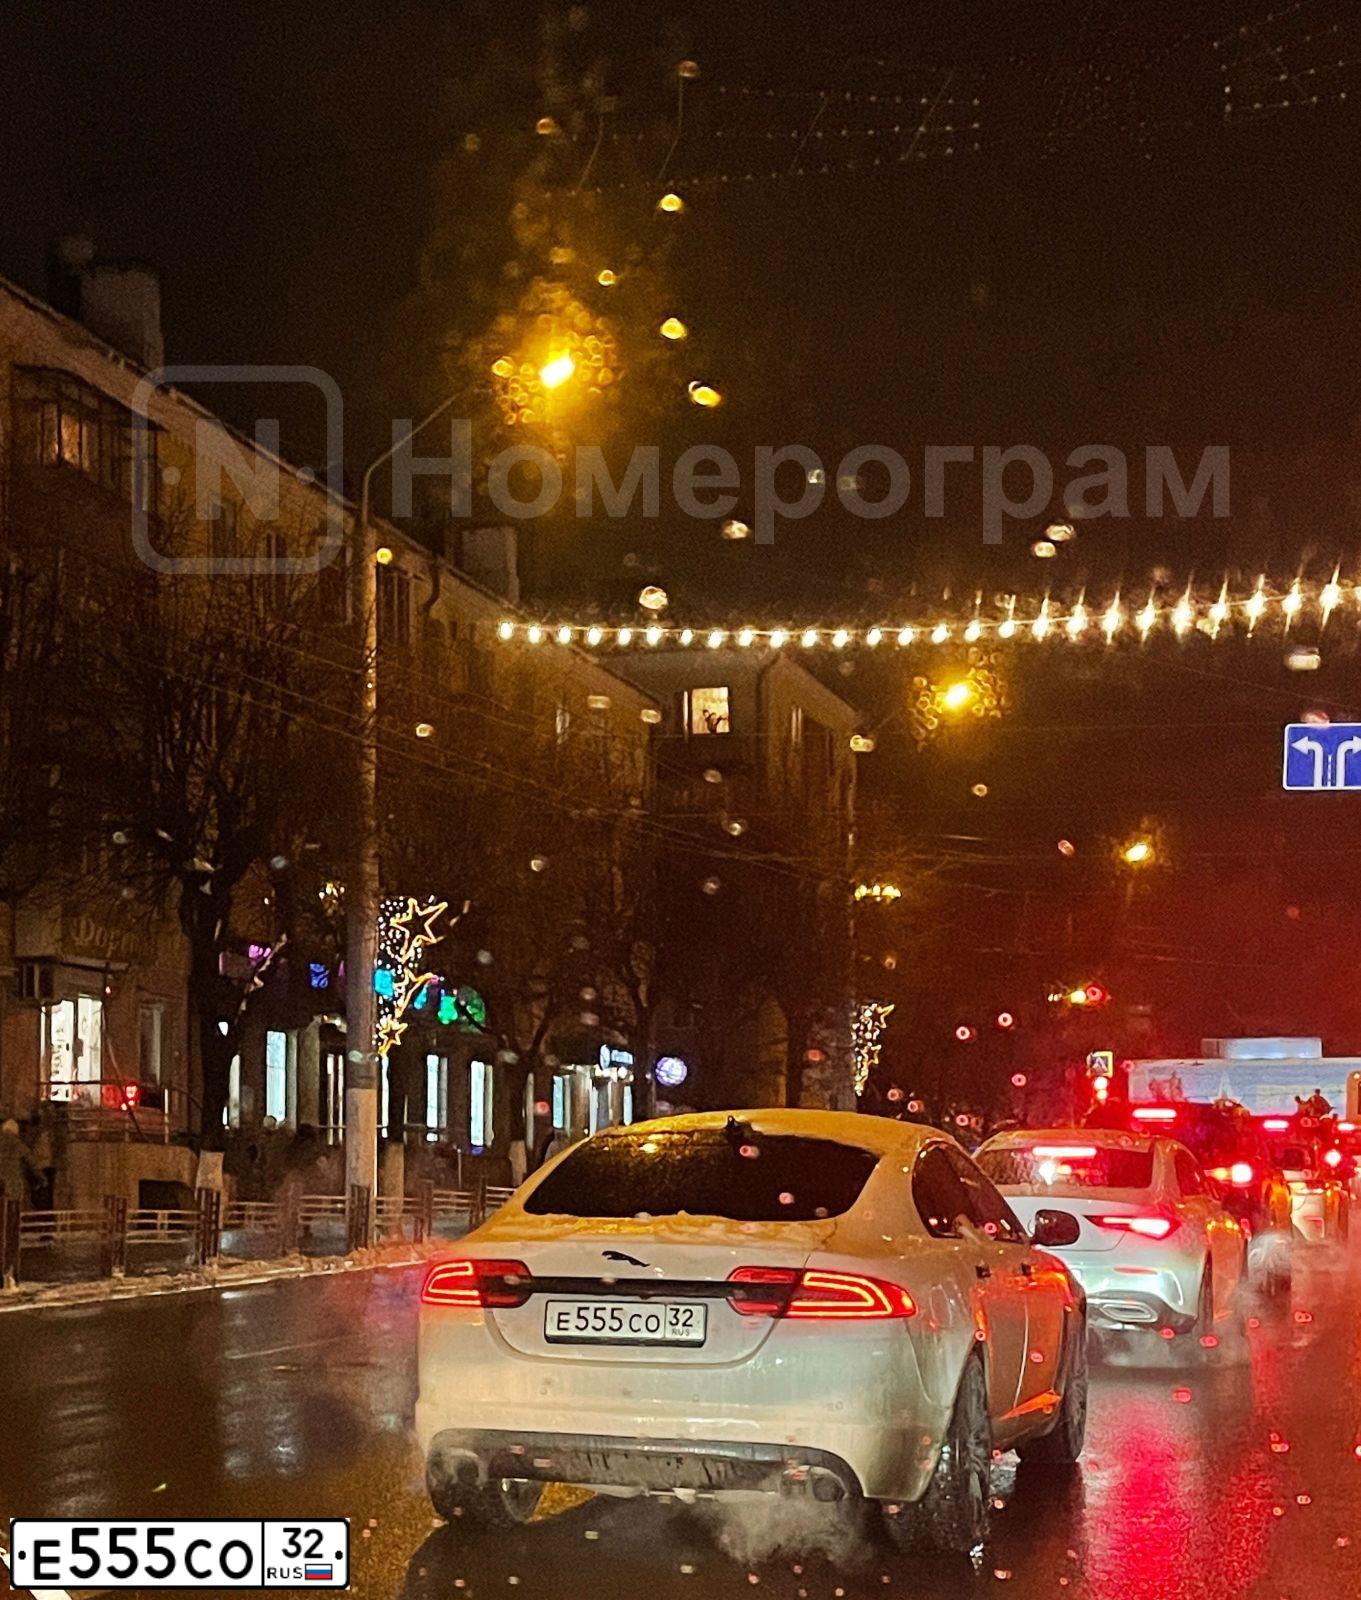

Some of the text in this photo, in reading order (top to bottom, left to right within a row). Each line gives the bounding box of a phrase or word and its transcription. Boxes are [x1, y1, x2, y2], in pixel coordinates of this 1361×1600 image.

[557, 1306, 694, 1333] Е555СО 32
[671, 1329, 690, 1337] RUS
